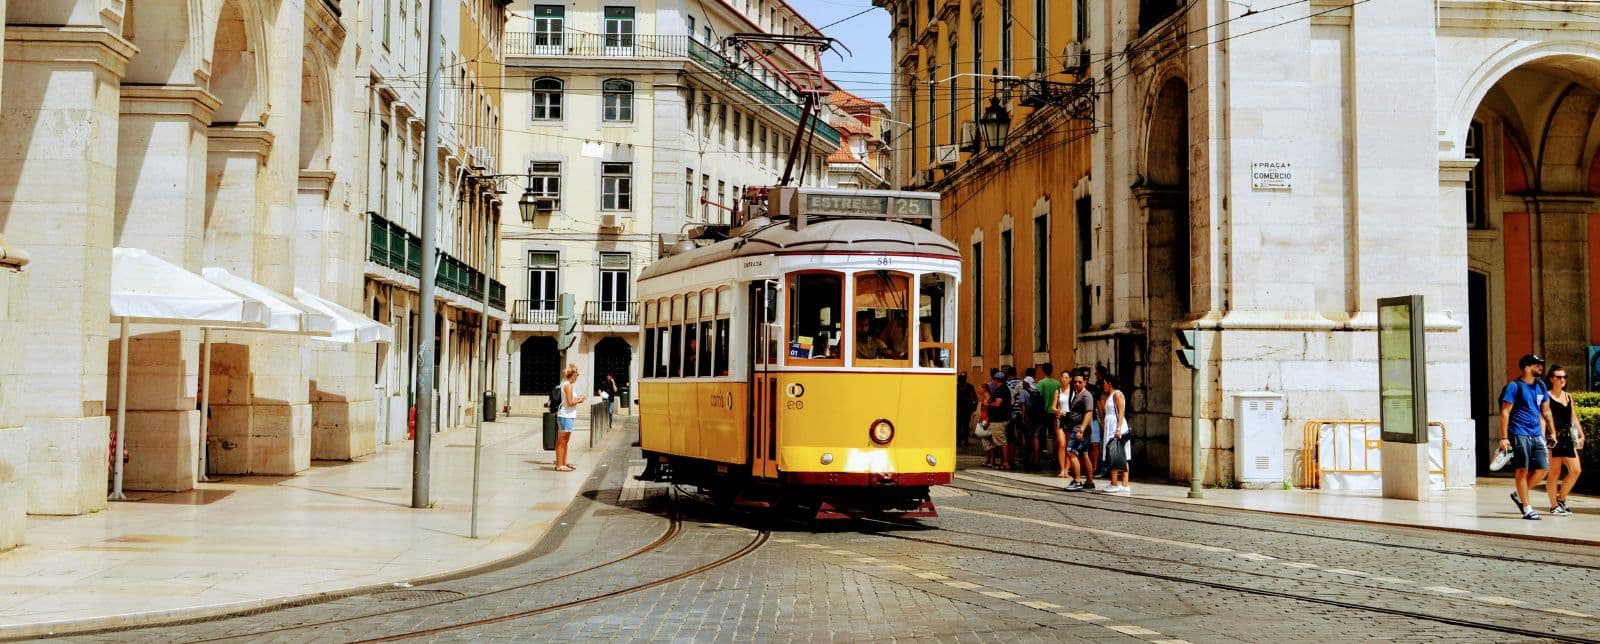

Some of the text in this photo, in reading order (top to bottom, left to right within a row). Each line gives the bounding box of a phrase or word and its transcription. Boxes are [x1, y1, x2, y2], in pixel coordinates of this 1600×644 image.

[1253, 172, 1292, 180] COMERCIO
[896, 199, 920, 214] 25
[877, 256, 892, 266] 581
